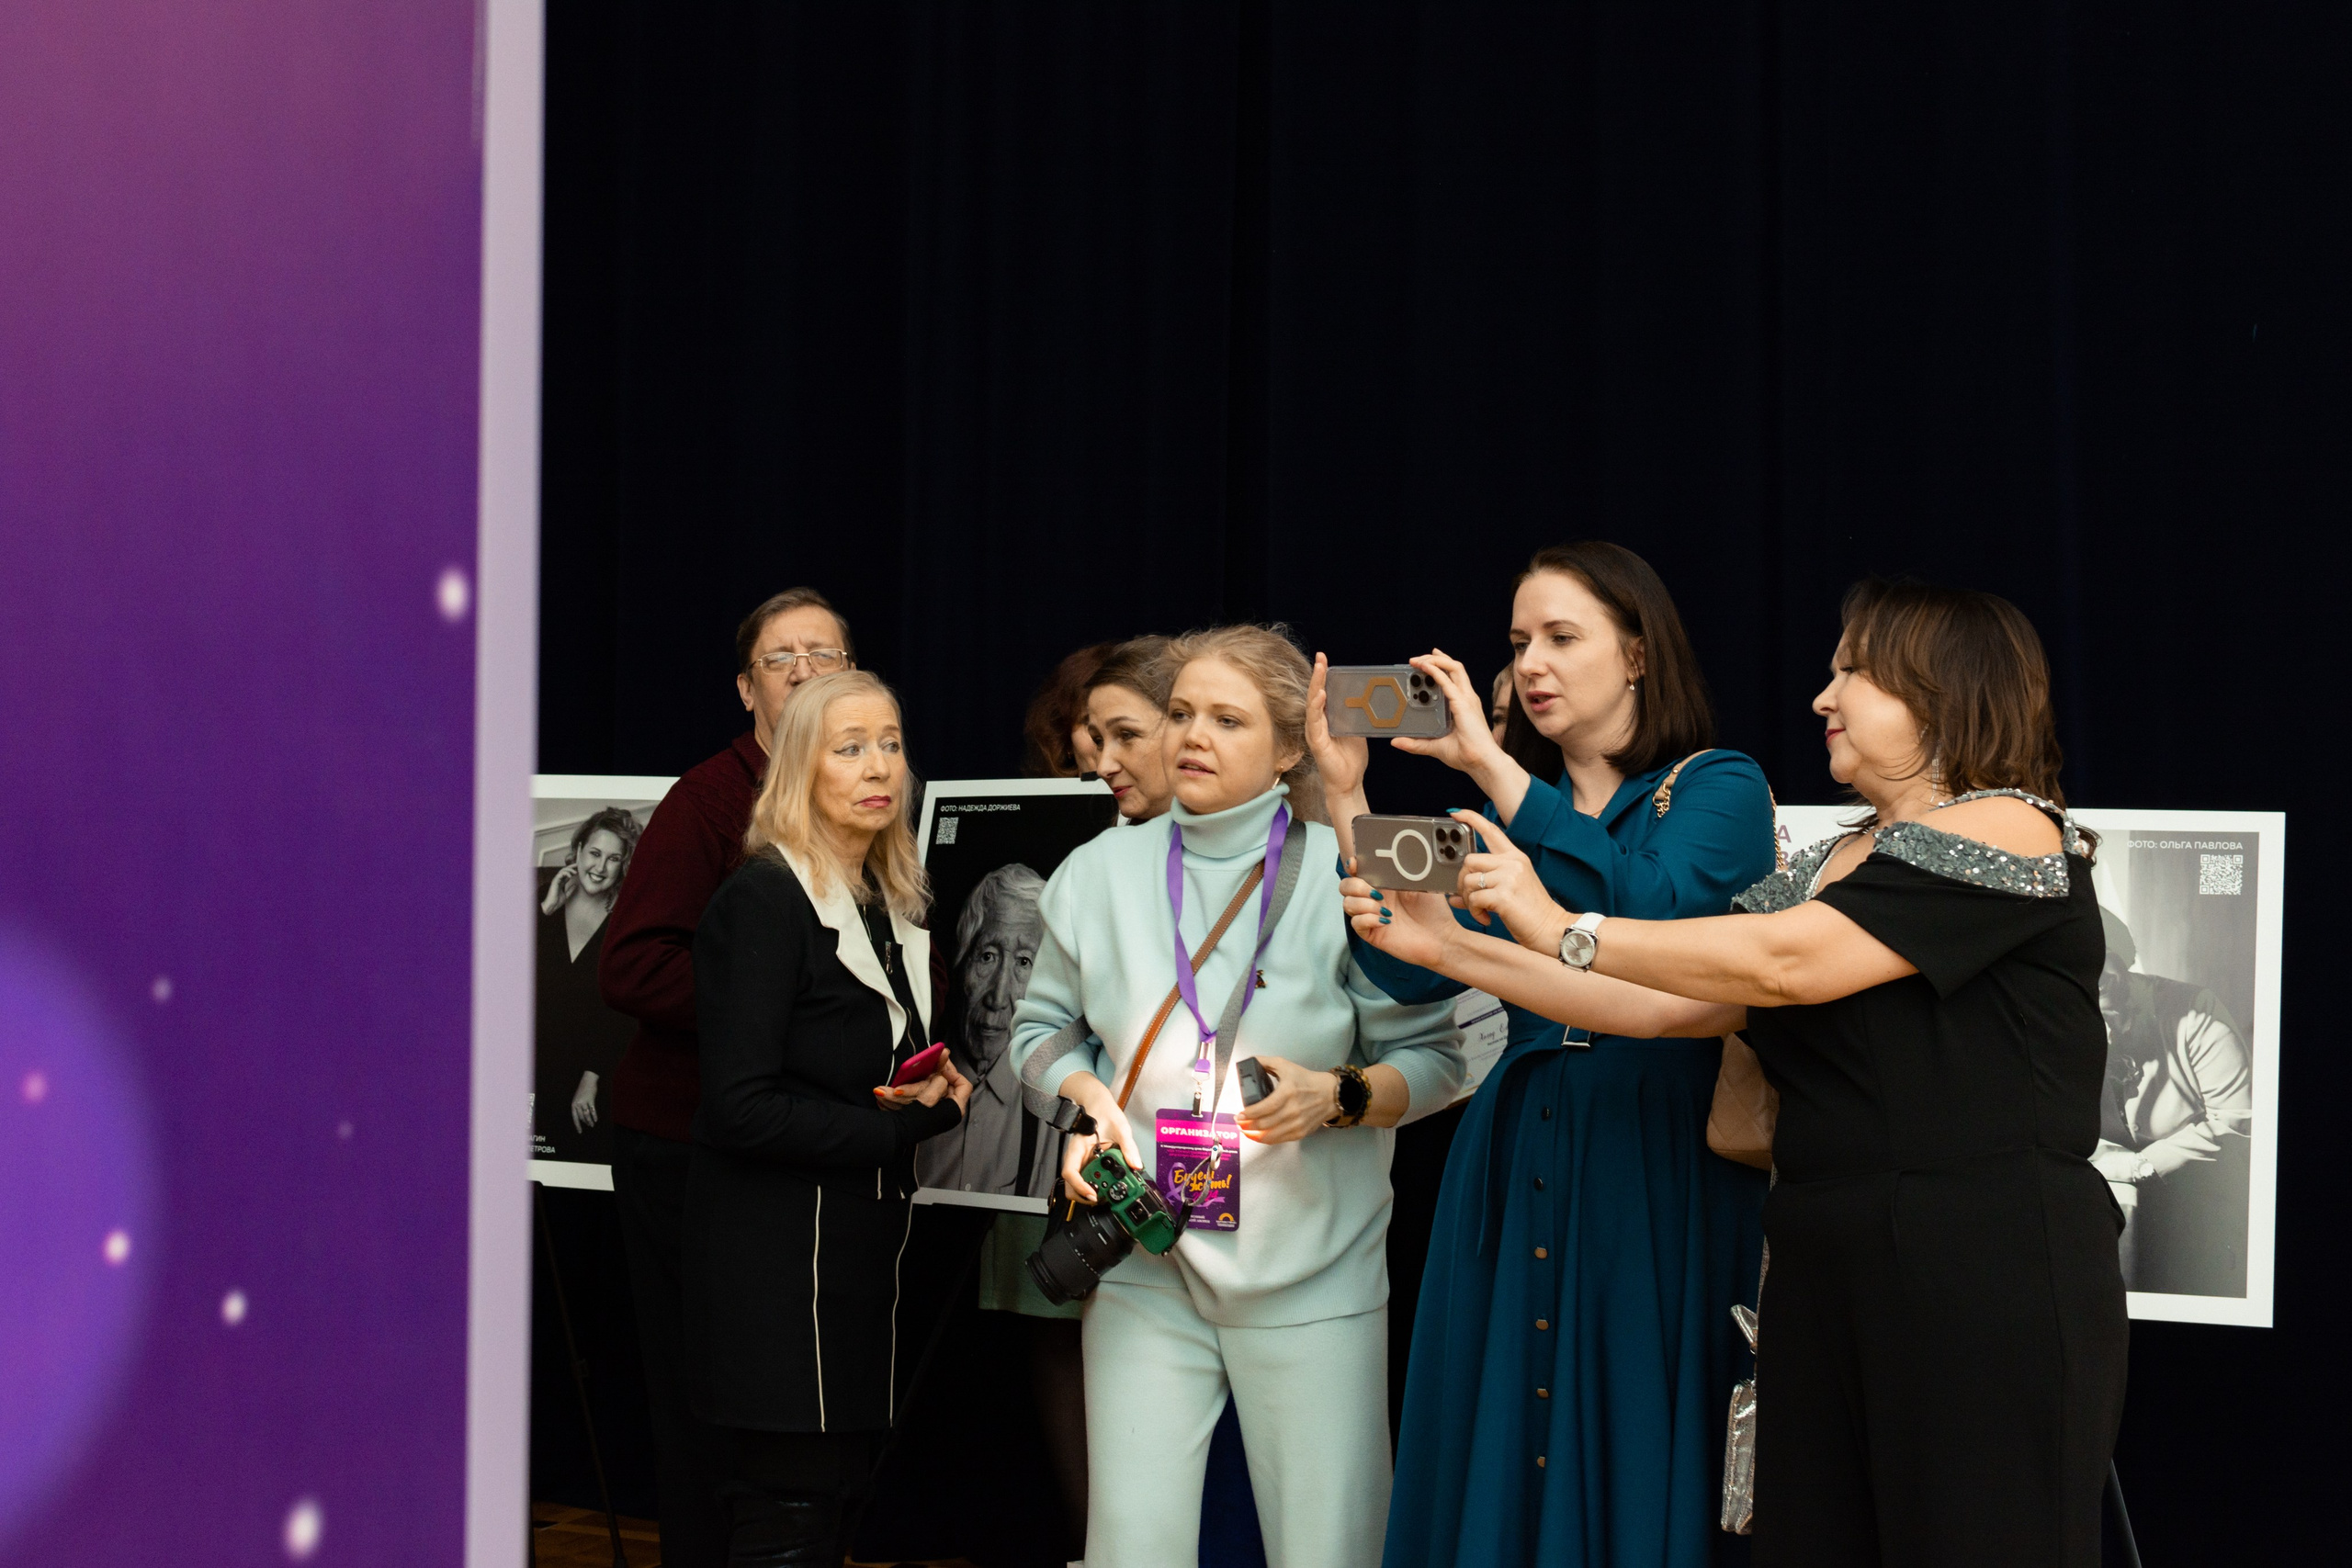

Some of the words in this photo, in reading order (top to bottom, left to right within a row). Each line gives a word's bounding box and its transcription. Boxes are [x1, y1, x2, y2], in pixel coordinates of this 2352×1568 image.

[958, 804, 987, 813] НАДЕЖДА
[987, 804, 1021, 812] ДОРЖИЕВА
[2127, 840, 2157, 849] ФОТО:
[2159, 840, 2192, 850] ОЛЬГА
[2194, 841, 2244, 851] ПАВЛОВА
[527, 1145, 556, 1154] ЕТРОВА
